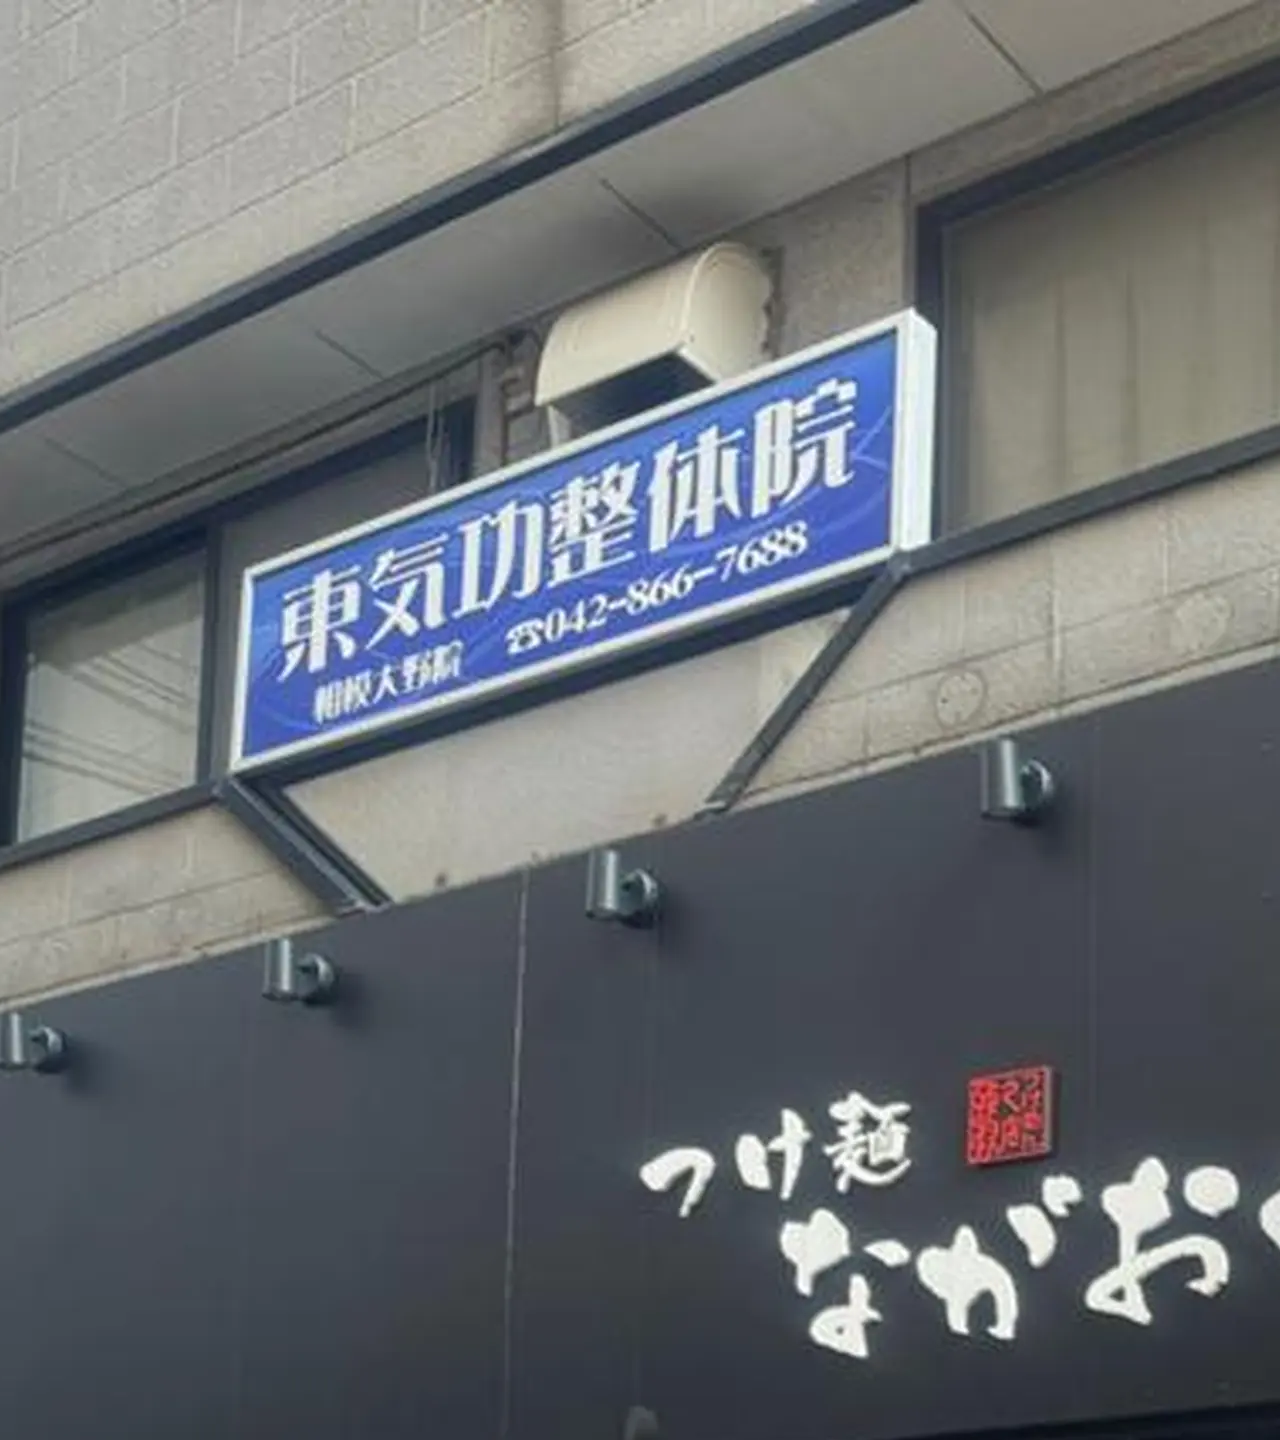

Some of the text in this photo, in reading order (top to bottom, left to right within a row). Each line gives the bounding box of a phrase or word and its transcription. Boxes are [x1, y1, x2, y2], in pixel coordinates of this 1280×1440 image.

[277, 377, 859, 682] 東気功整体院
[545, 520, 810, 647] 042-866-7688
[638, 1090, 913, 1217] つけ麺
